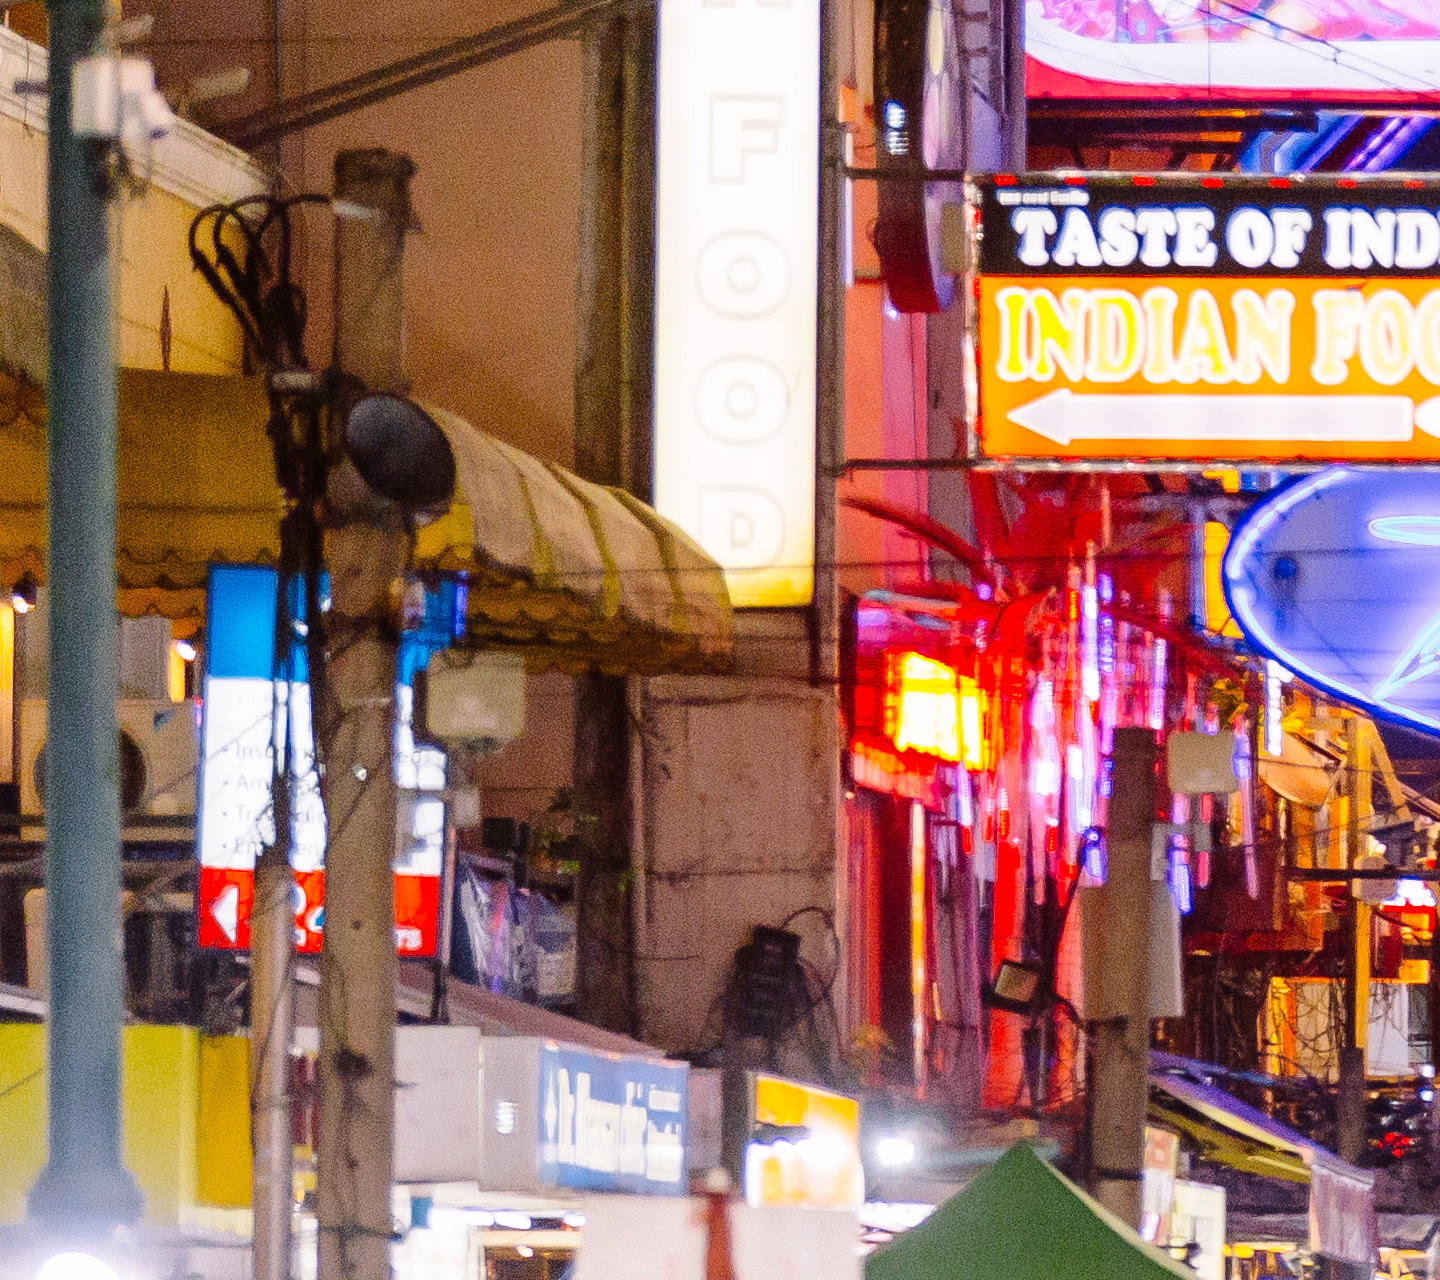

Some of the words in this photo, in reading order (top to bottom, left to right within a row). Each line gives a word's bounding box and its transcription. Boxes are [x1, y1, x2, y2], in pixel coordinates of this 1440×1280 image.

[1012, 207, 1218, 271] TASTE
[1227, 207, 1312, 270] OF
[995, 285, 1297, 387] INDIAN
